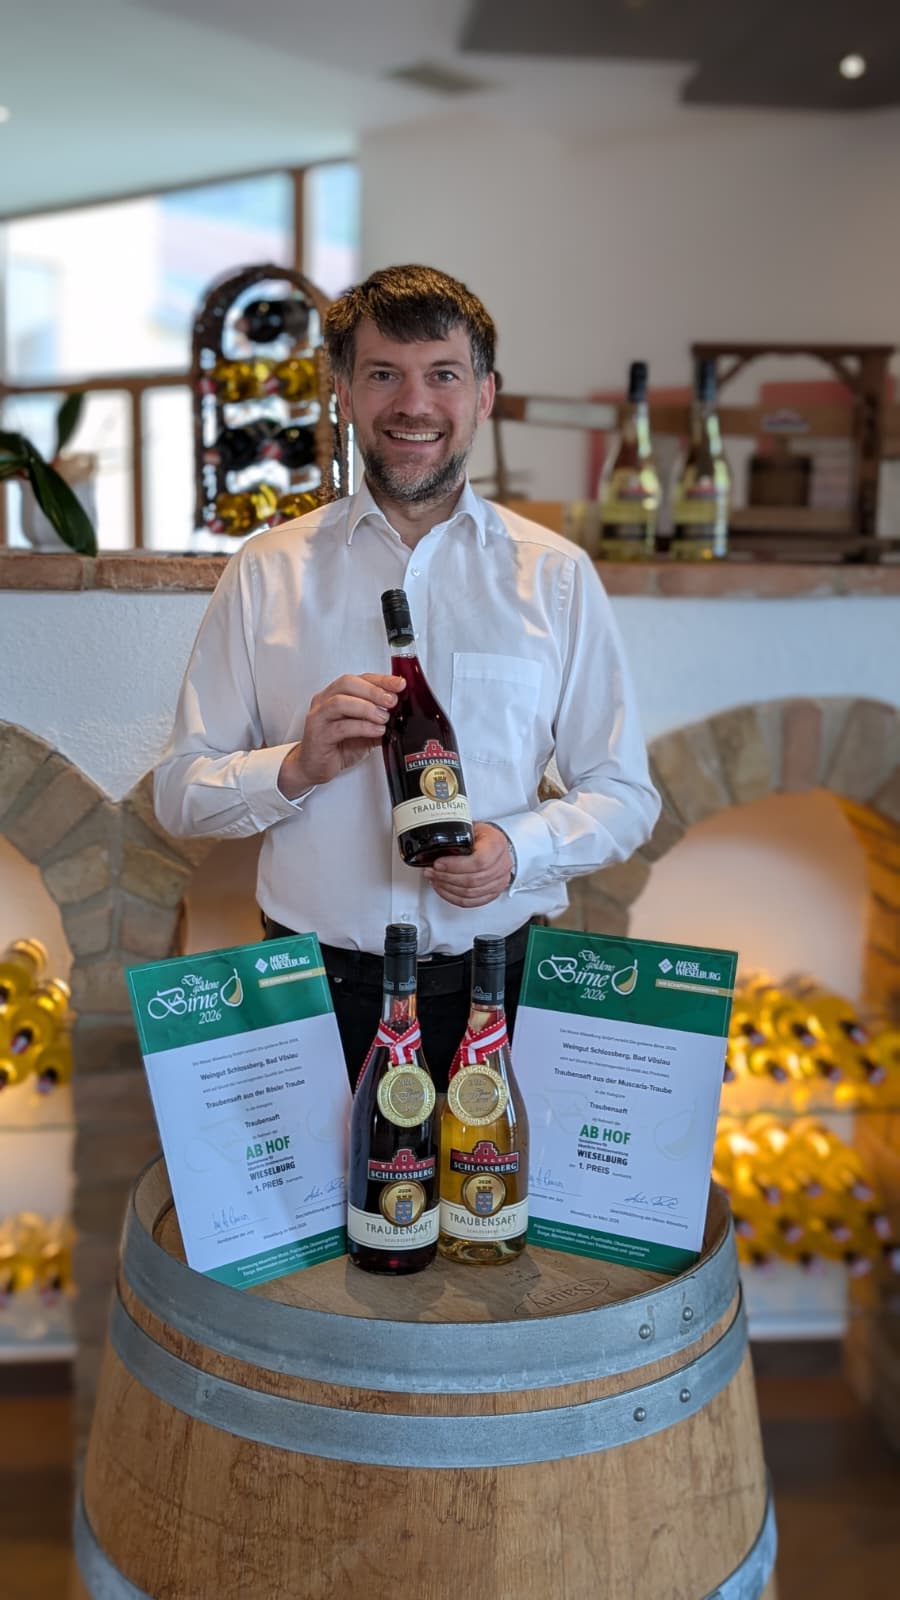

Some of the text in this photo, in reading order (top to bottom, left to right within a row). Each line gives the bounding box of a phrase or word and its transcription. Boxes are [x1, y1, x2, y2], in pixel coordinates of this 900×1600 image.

[413, 801, 466, 814] TRAUBENSAFT
[269, 953, 290, 963] MESSE
[269, 956, 310, 971] WIESELBURG
[675, 960, 701, 971] MESSE
[537, 953, 610, 988] Birne
[675, 966, 721, 982] WIESELBURG
[580, 987, 609, 1001] 2026
[147, 987, 218, 1020] Birne
[198, 1009, 222, 1025] 2026
[562, 1042, 671, 1066] Weingut Schlossberg, Bad Vöslau
[200, 1070, 229, 1081] Weingut
[227, 1061, 265, 1074] Schlossberg,
[265, 1056, 278, 1065] Bad
[554, 1067, 592, 1080] Traubensaft
[592, 1075, 604, 1083] aus
[605, 1076, 617, 1085] der
[618, 1079, 673, 1094] Muscaris-Traube
[205, 1095, 242, 1109] Traubensaft
[243, 1092, 254, 1100] aus
[254, 1088, 265, 1097] der
[285, 1079, 305, 1089] Traube
[589, 1101, 628, 1114] Traubensaft
[245, 1114, 281, 1128] Traubensaft
[579, 1124, 632, 1145] AB HOF
[246, 1135, 290, 1160] AB HOF
[577, 1149, 628, 1166] WIESELBURG
[249, 1161, 296, 1181] WIESELBURG
[371, 1168, 433, 1180] SCHLOSSBERG
[453, 1161, 517, 1173] SCHLOSSBERG
[578, 1161, 585, 1171] 1.
[586, 1163, 610, 1175] PREIS
[255, 1184, 262, 1193] 1.
[262, 1178, 284, 1191] PREIS
[449, 1212, 517, 1227] TRAUBENSAFT
[365, 1221, 433, 1235] TRAUBENSAFT
